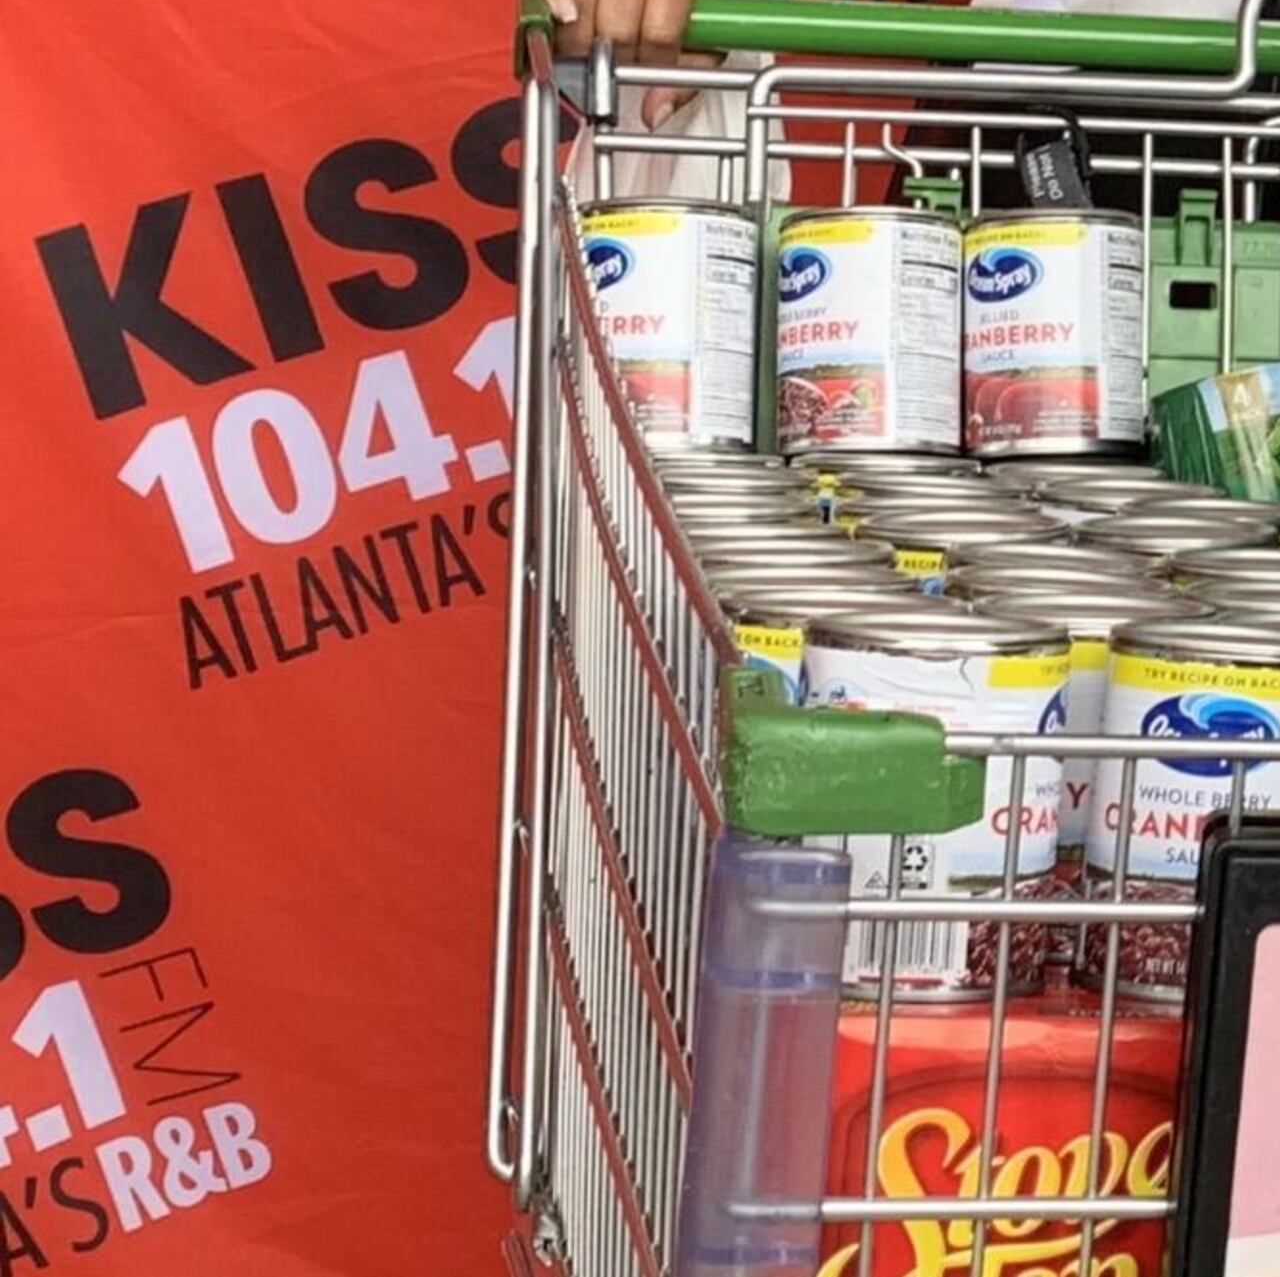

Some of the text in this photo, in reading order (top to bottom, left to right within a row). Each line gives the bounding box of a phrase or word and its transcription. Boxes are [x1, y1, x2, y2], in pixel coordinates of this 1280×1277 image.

[964, 323, 1075, 350] RANBERRY
[179, 499, 514, 691] ATLANTA'
[1170, 670, 1218, 685] RECIPE
[1139, 784, 1206, 806] WHOLE
[99, 947, 243, 1107] FM
[95, 1100, 272, 1233] R&B
